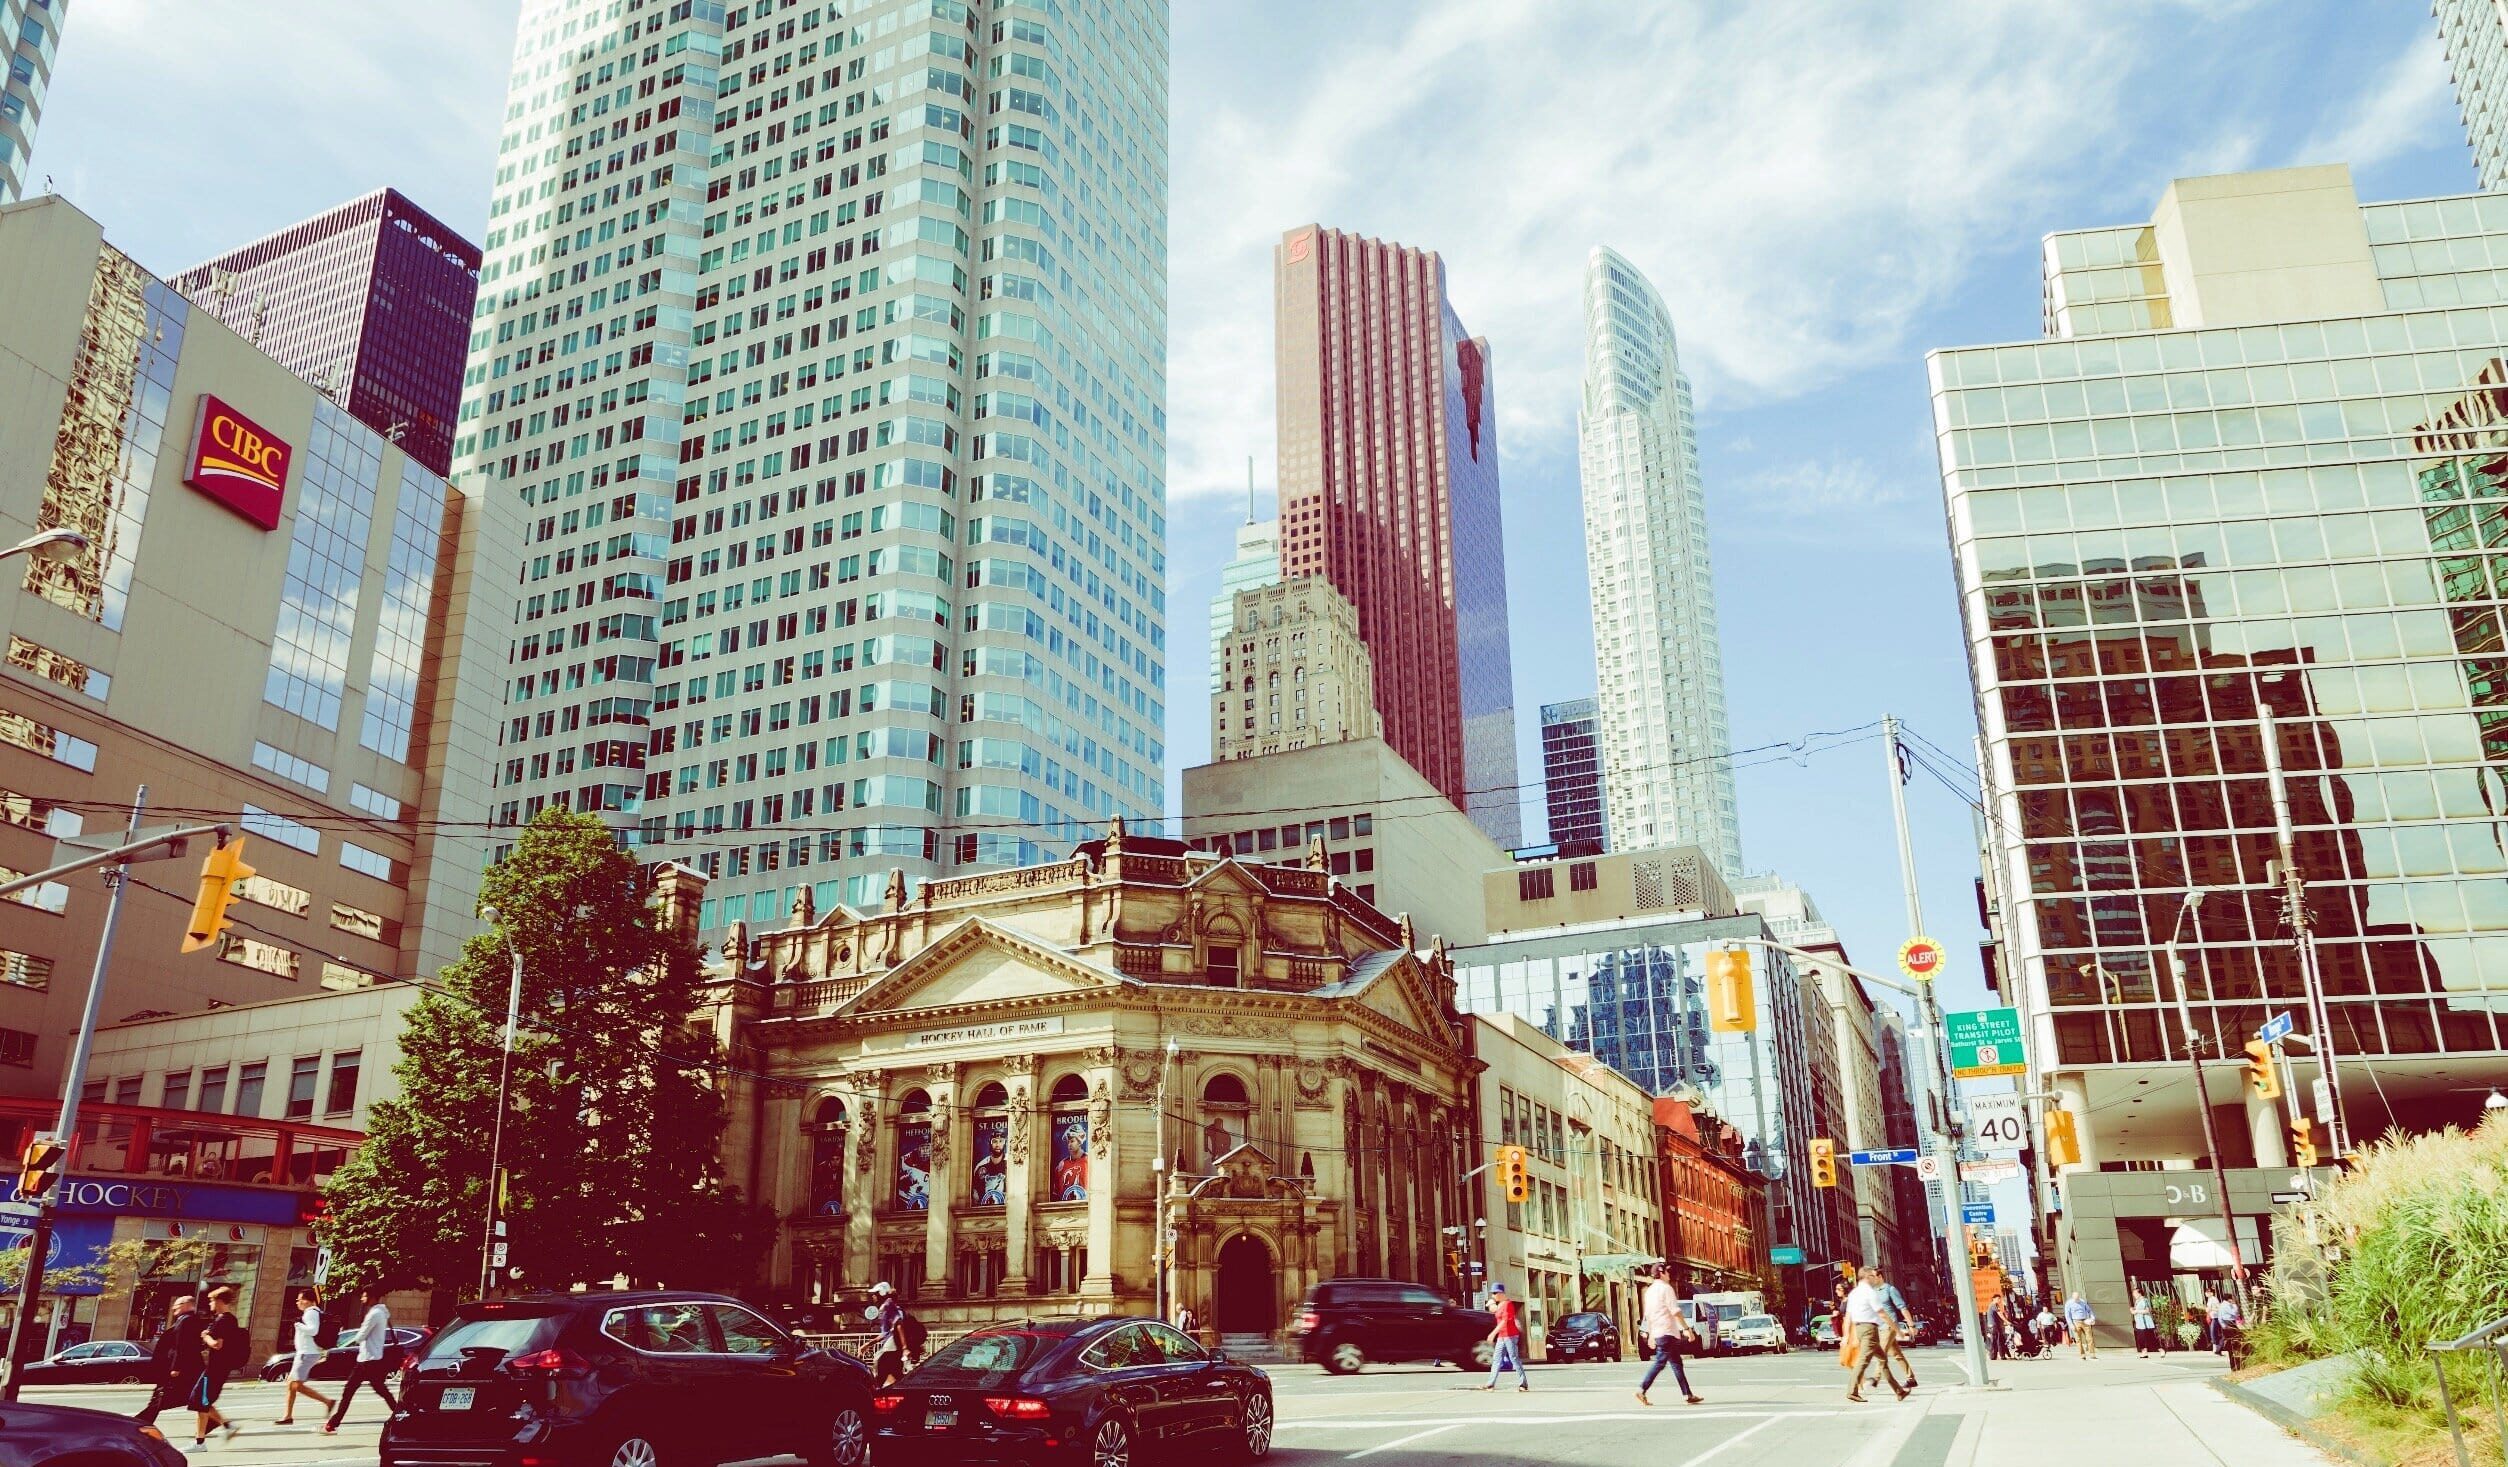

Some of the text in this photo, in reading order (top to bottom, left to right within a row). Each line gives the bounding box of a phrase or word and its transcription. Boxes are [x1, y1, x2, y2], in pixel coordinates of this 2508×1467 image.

[212, 415, 282, 478] CIBC
[1907, 951, 1937, 965] ALERT
[921, 1021, 1047, 1044] HOCKEY HALL OF FAME
[1957, 1020, 2010, 1032] KING STREET
[1954, 1028, 2016, 1040] TRANSIT PILOT
[1975, 1099, 2016, 1110] MAXIMUM
[1981, 1117, 2020, 1142] 40
[1869, 1152, 1892, 1161] Front
[59, 1182, 191, 1209] HOCKEY
[1, 1214, 21, 1225] Yonge
